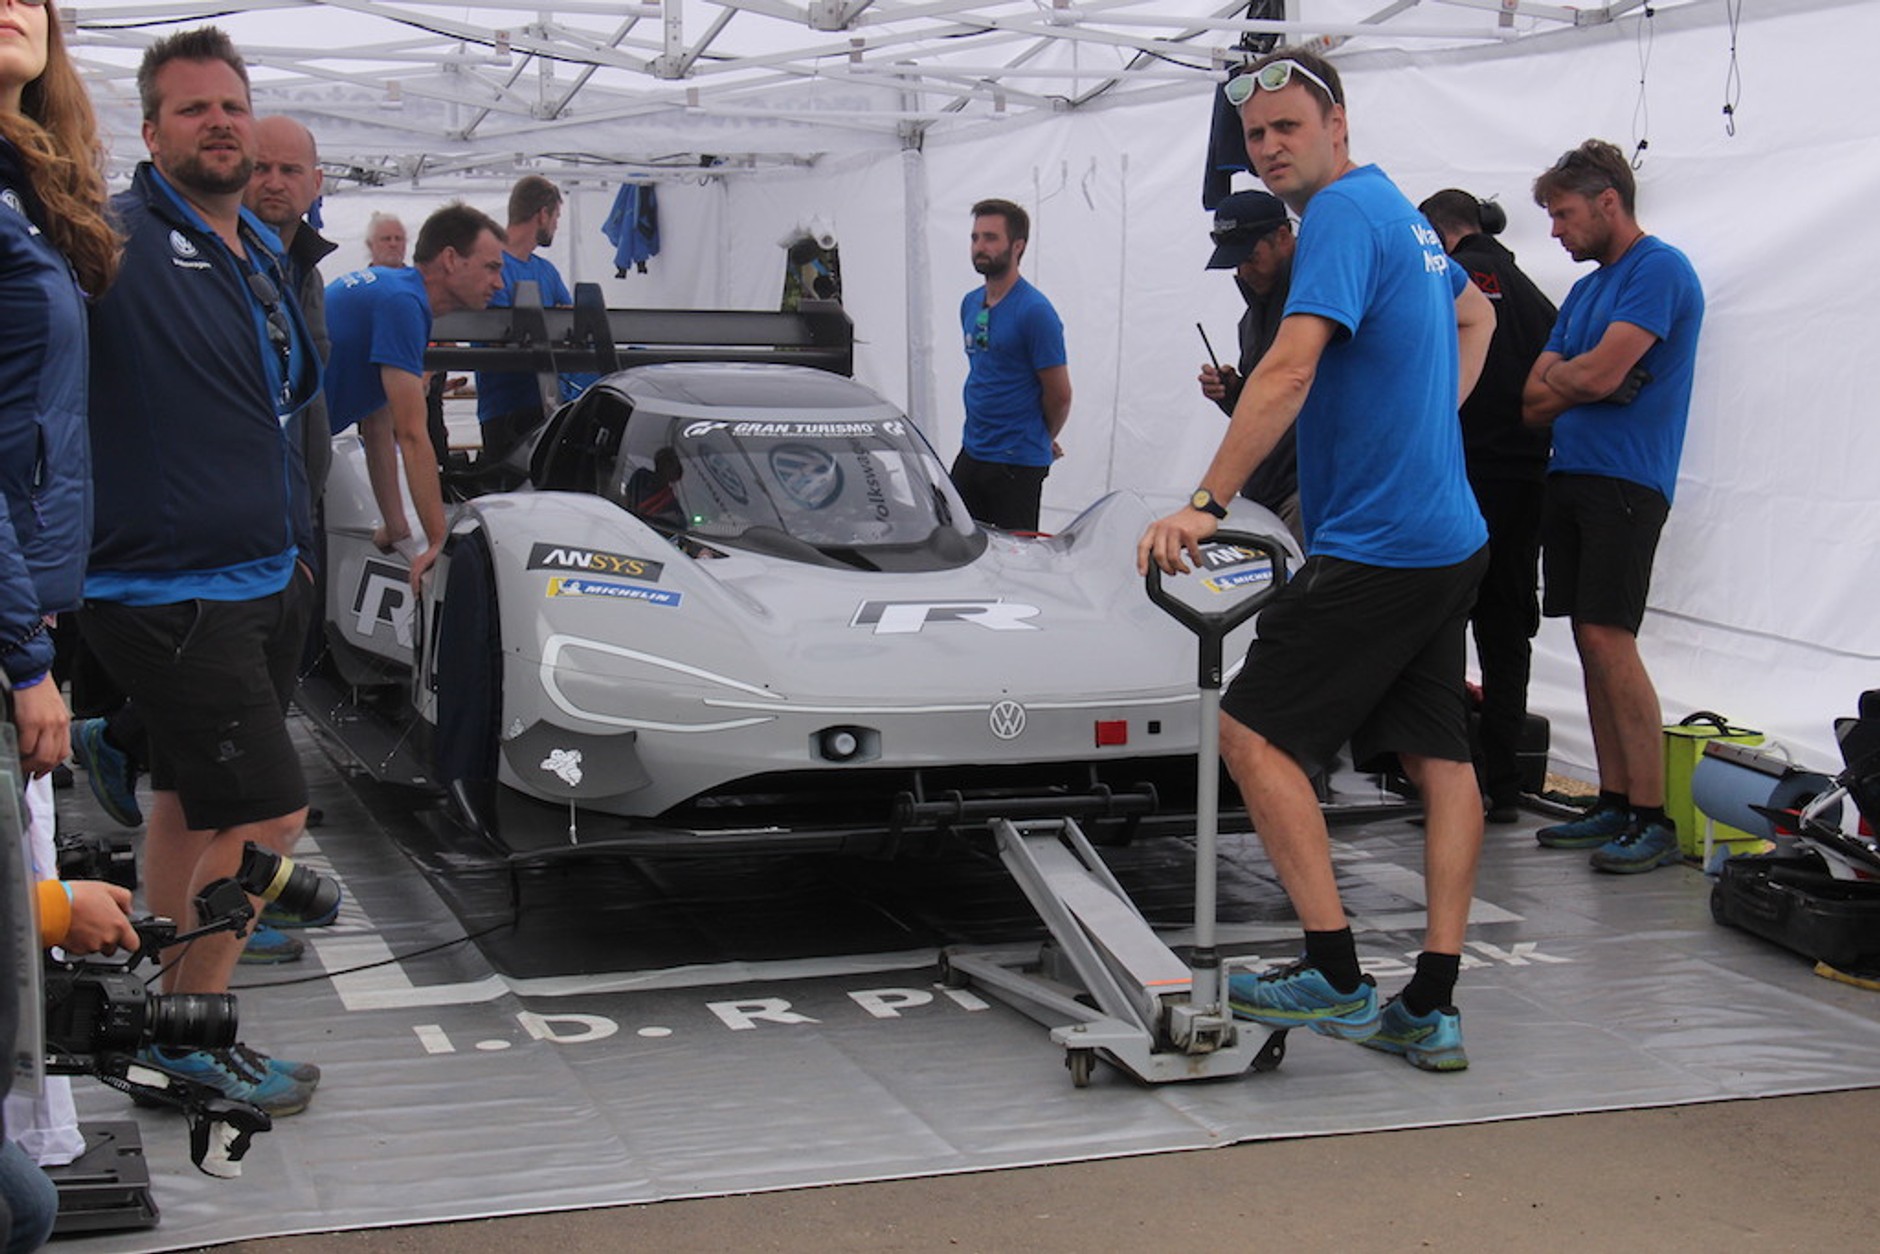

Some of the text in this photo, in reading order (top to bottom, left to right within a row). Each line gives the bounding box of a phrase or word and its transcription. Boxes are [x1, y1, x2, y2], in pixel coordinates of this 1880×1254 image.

[733, 422, 874, 433] GRAN TURISMO
[542, 548, 646, 576] ANSYS
[583, 585, 671, 602] MICHELIN
[706, 997, 822, 1031] R
